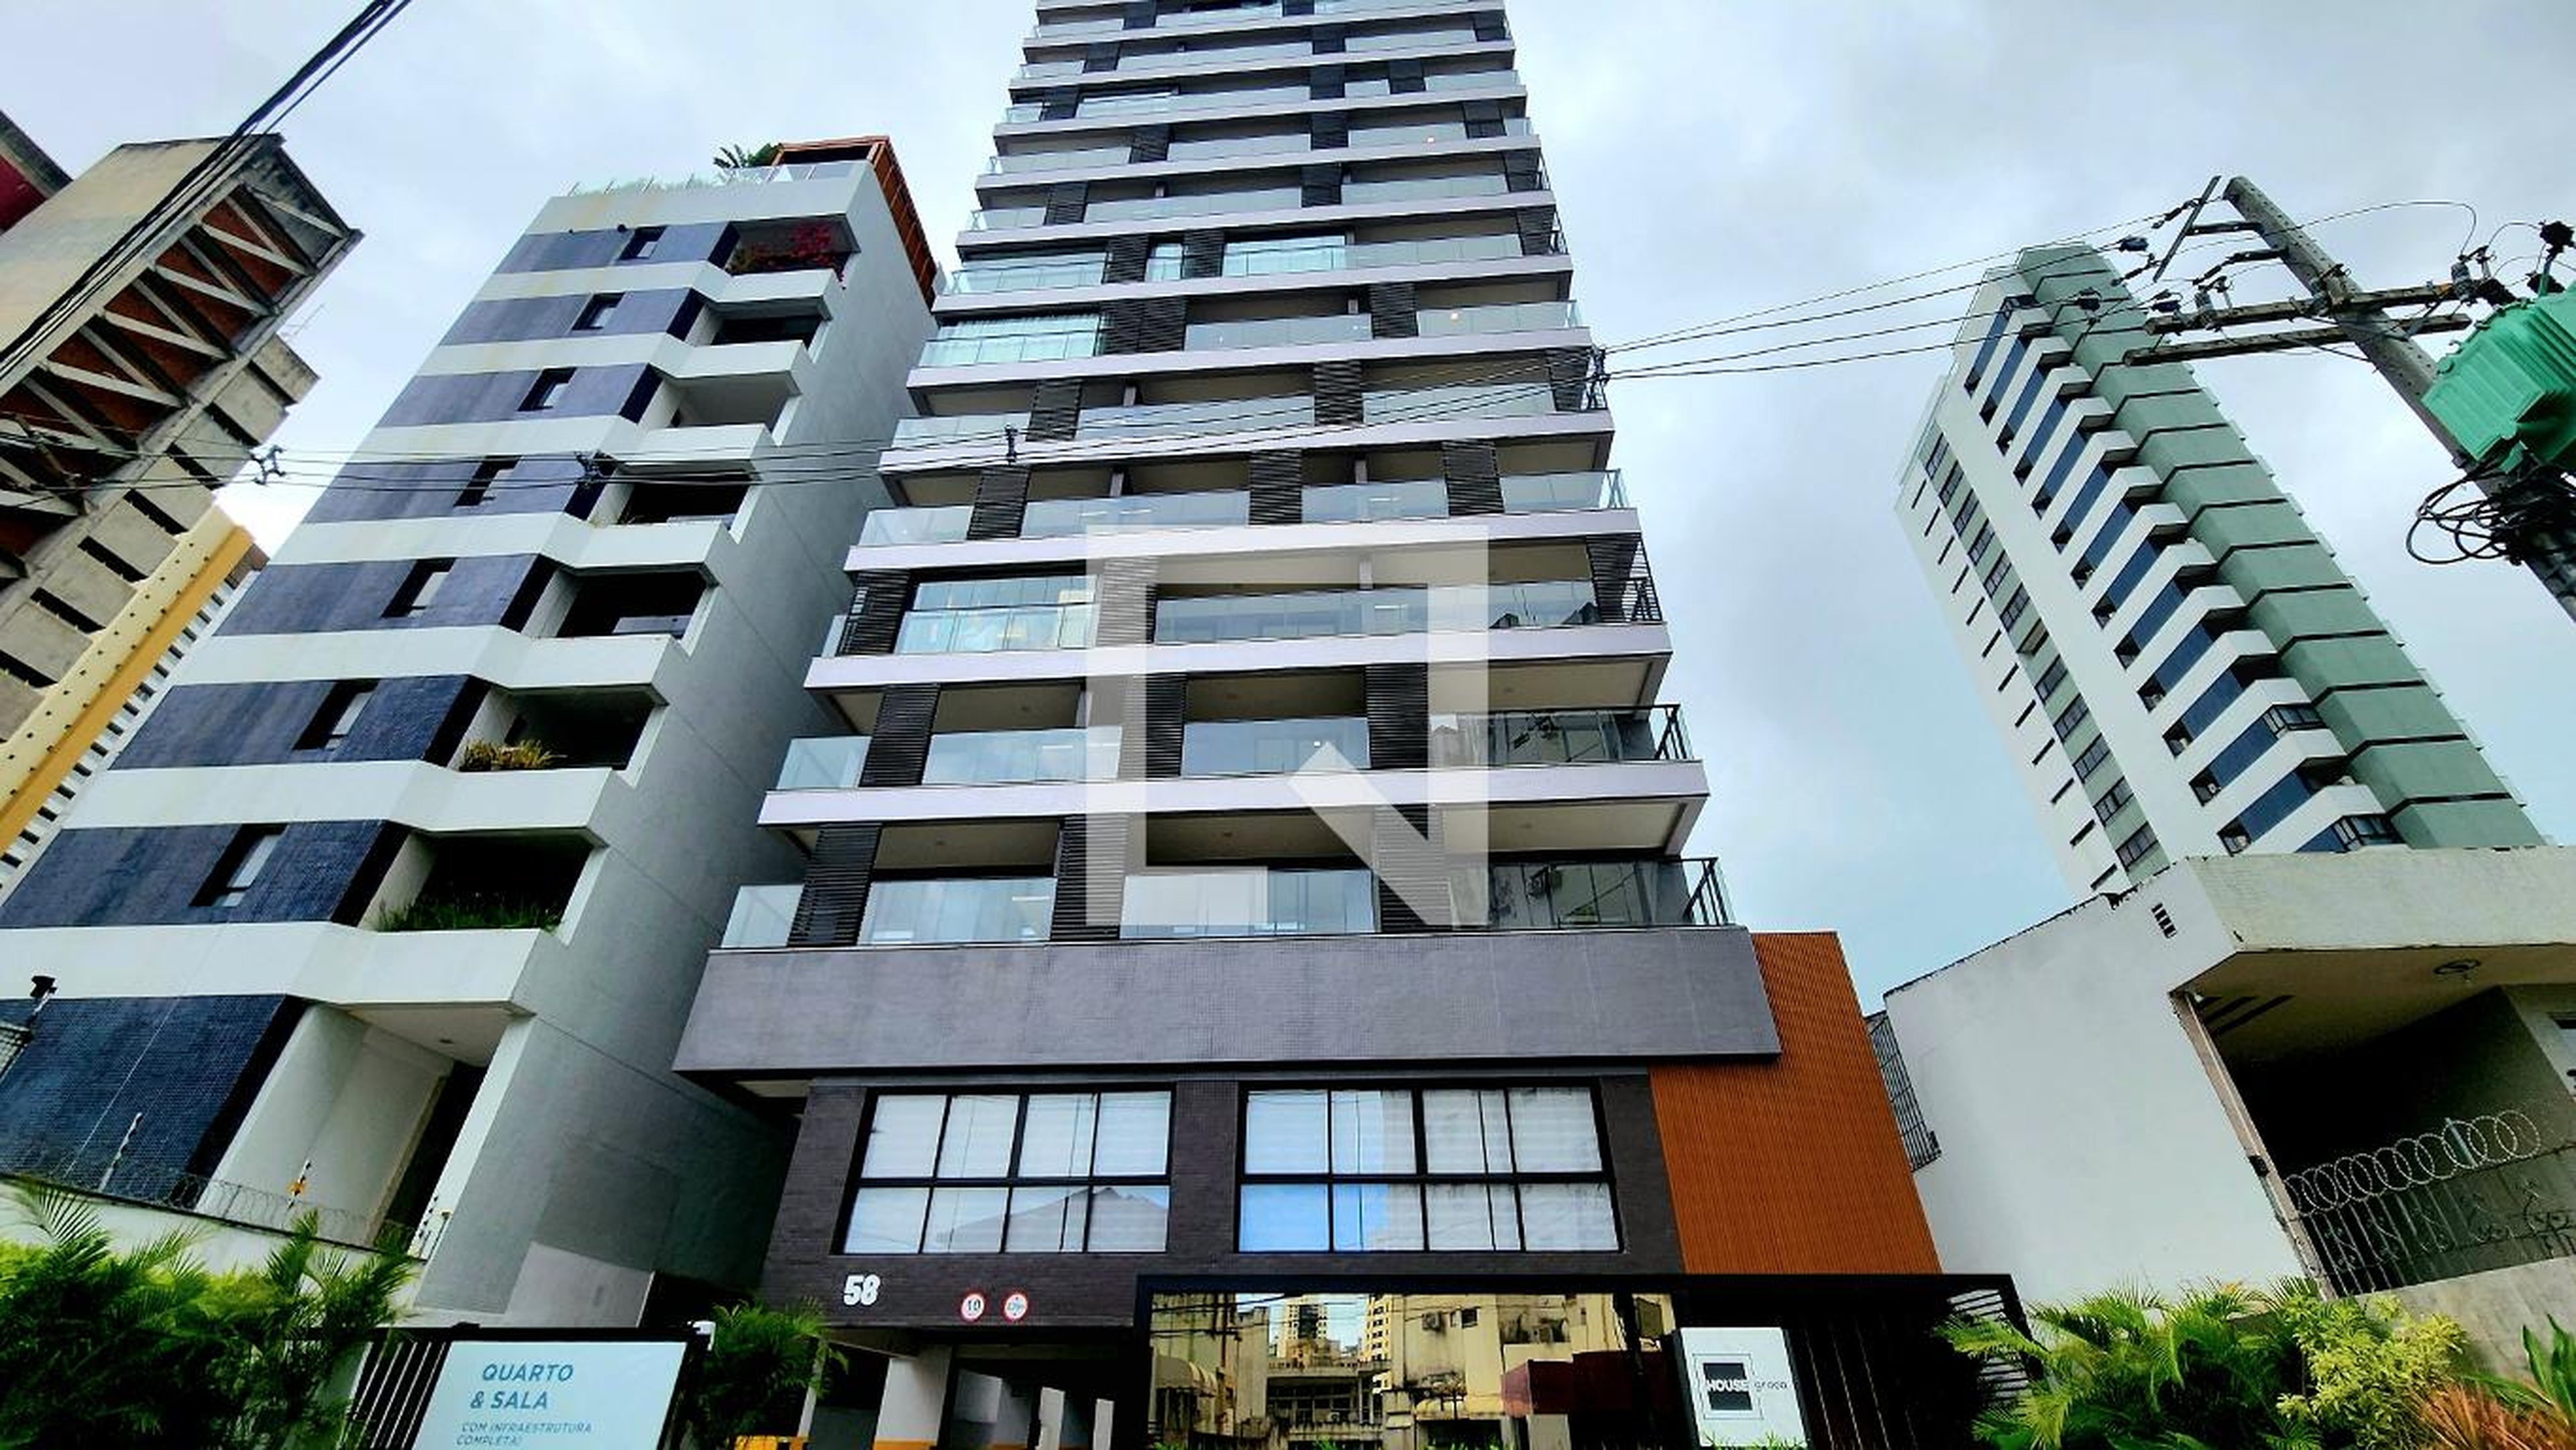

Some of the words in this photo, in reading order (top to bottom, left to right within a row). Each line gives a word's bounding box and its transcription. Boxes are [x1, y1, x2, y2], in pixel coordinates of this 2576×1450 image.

[843, 1274, 881, 1306] 58
[482, 1363, 574, 1382] QUARTO
[1706, 1379, 1750, 1392] HOUSE
[470, 1390, 485, 1409] &
[490, 1390, 548, 1409] SALA
[462, 1423, 488, 1433] COM
[490, 1423, 592, 1434] INFRAESTRUTURA
